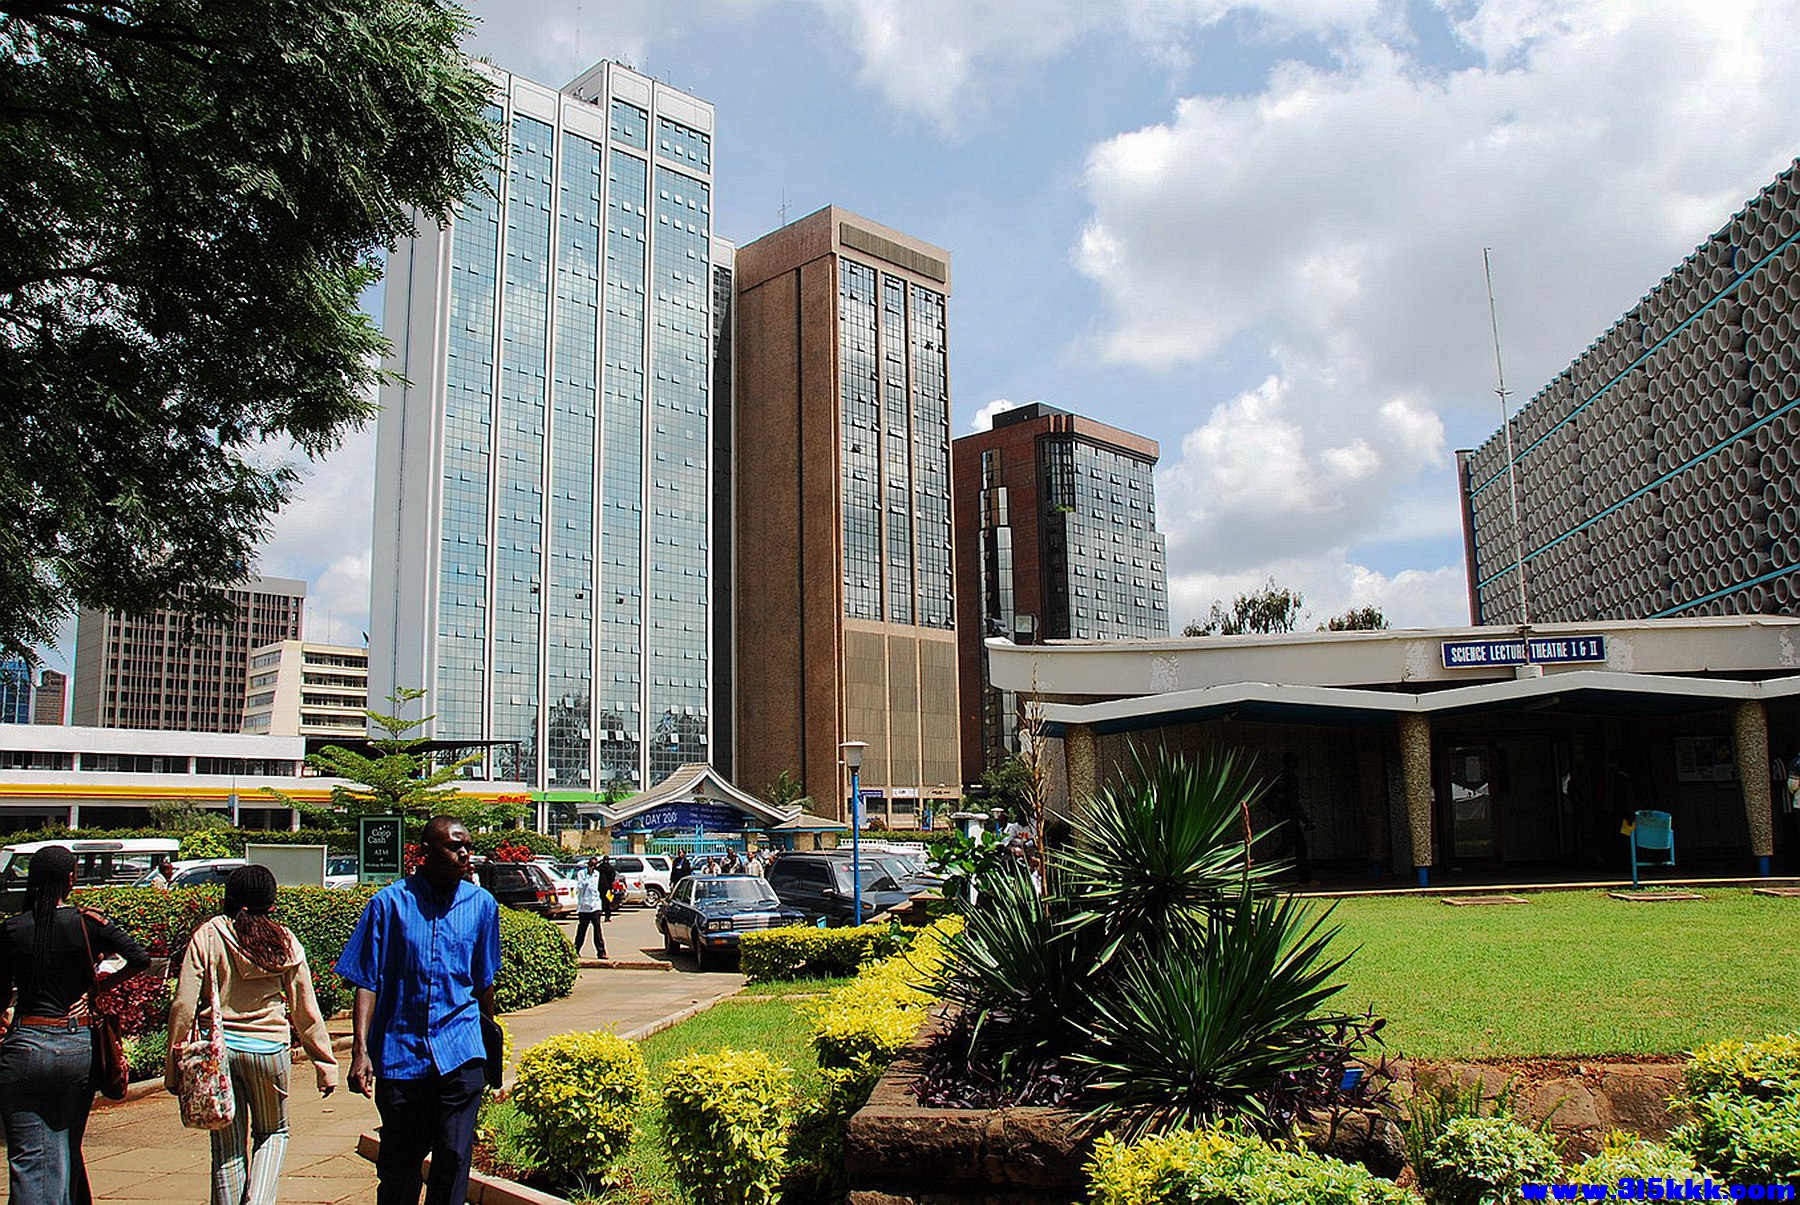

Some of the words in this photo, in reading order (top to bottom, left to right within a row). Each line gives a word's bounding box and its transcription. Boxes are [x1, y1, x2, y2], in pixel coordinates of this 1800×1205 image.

[1451, 645, 1487, 663] SCIENCE
[1490, 644, 1527, 661] LECTURE
[1530, 642, 1568, 660] THEATRE
[1580, 641, 1587, 657] &
[645, 813, 661, 825] DAY
[367, 834, 386, 844] Cash
